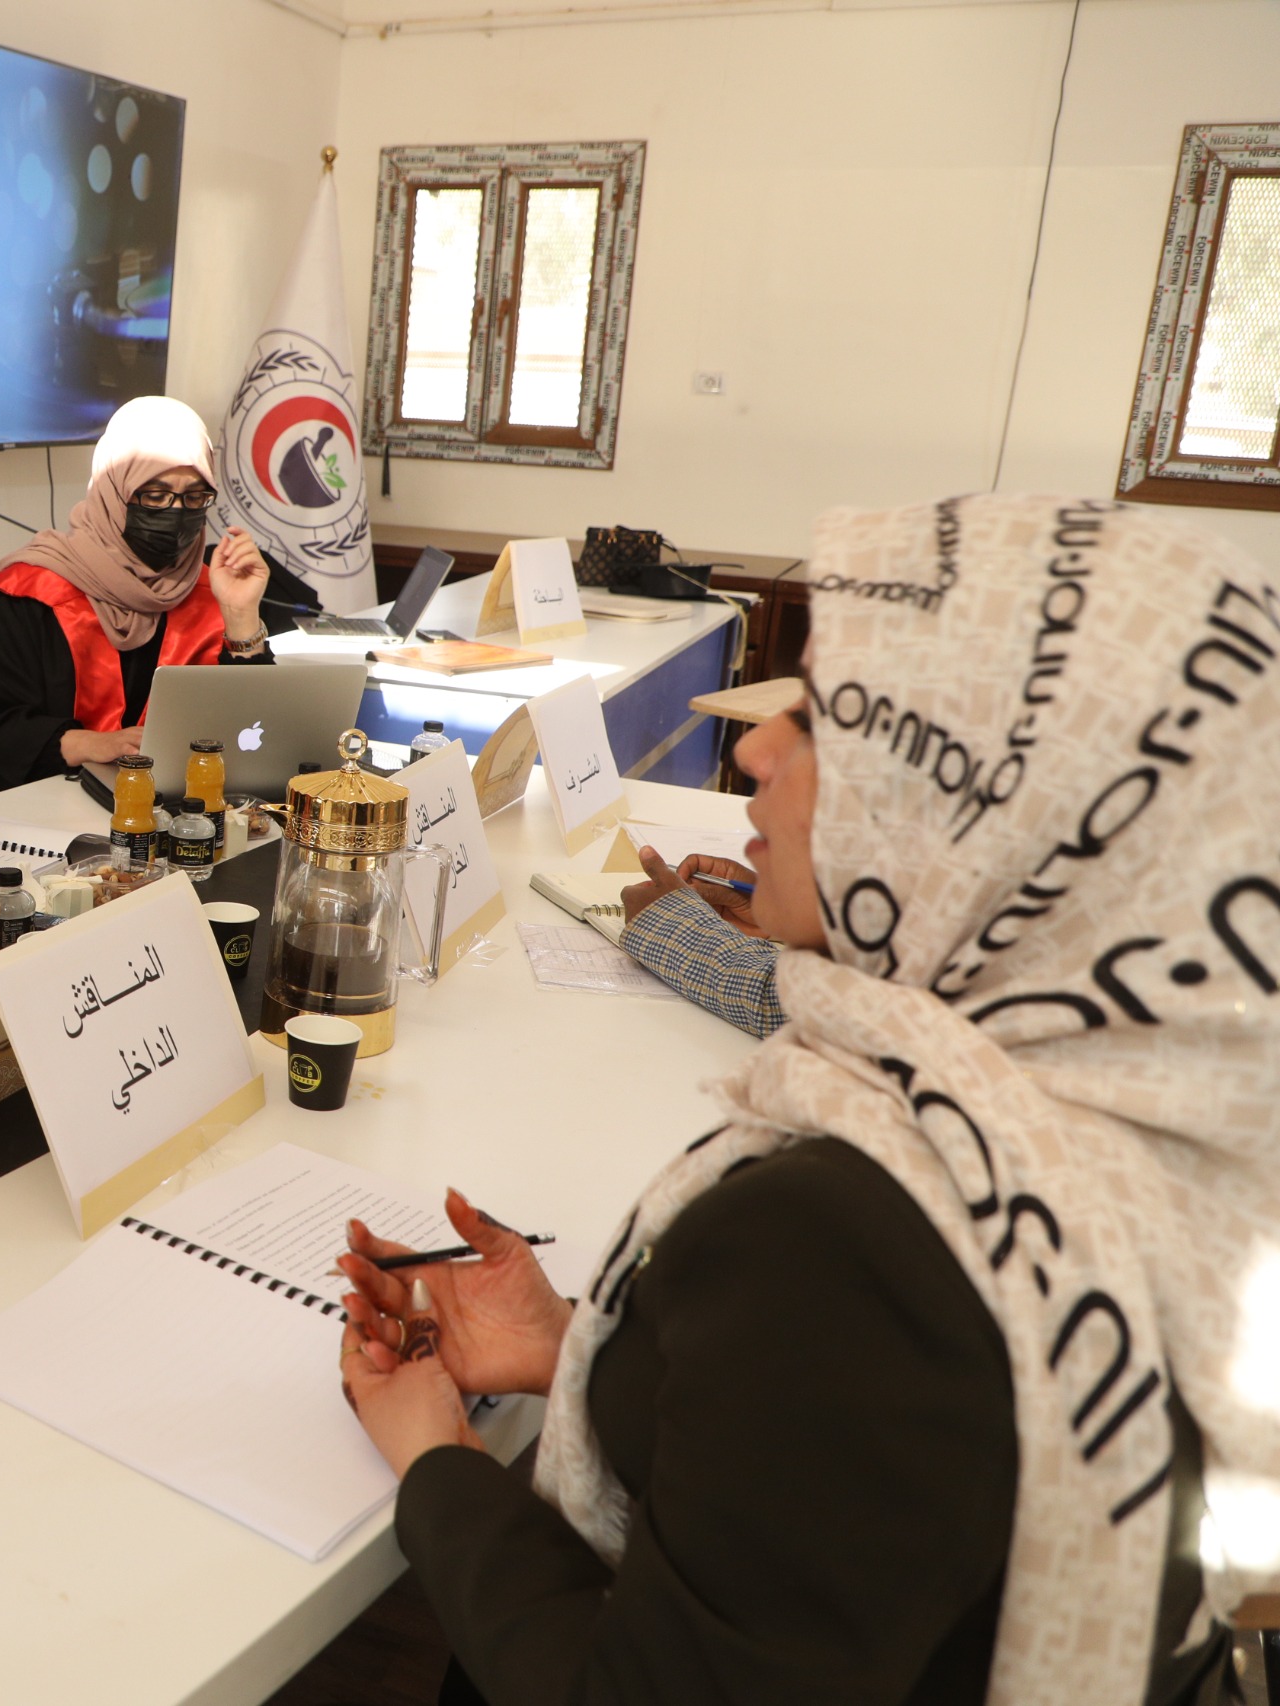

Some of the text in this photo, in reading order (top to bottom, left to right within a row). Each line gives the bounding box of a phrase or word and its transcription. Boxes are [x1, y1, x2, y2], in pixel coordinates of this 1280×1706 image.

[1187, 144, 1204, 195] FORCEWIN
[1170, 235, 1187, 286] FORCEWIN
[1189, 236, 1208, 286] FORCEWIN
[1153, 324, 1170, 374] FORCEWIN
[1173, 324, 1190, 375] FORCEWIN
[1136, 411, 1153, 460] FORCEWIN
[1156, 411, 1173, 460] FORCEWIN
[231, 478, 252, 509] 2014
[566, 753, 601, 793] المشرف
[411, 786, 457, 845] المناقش
[62, 943, 165, 1039] المناقش
[111, 1023, 179, 1116] الداخلي
